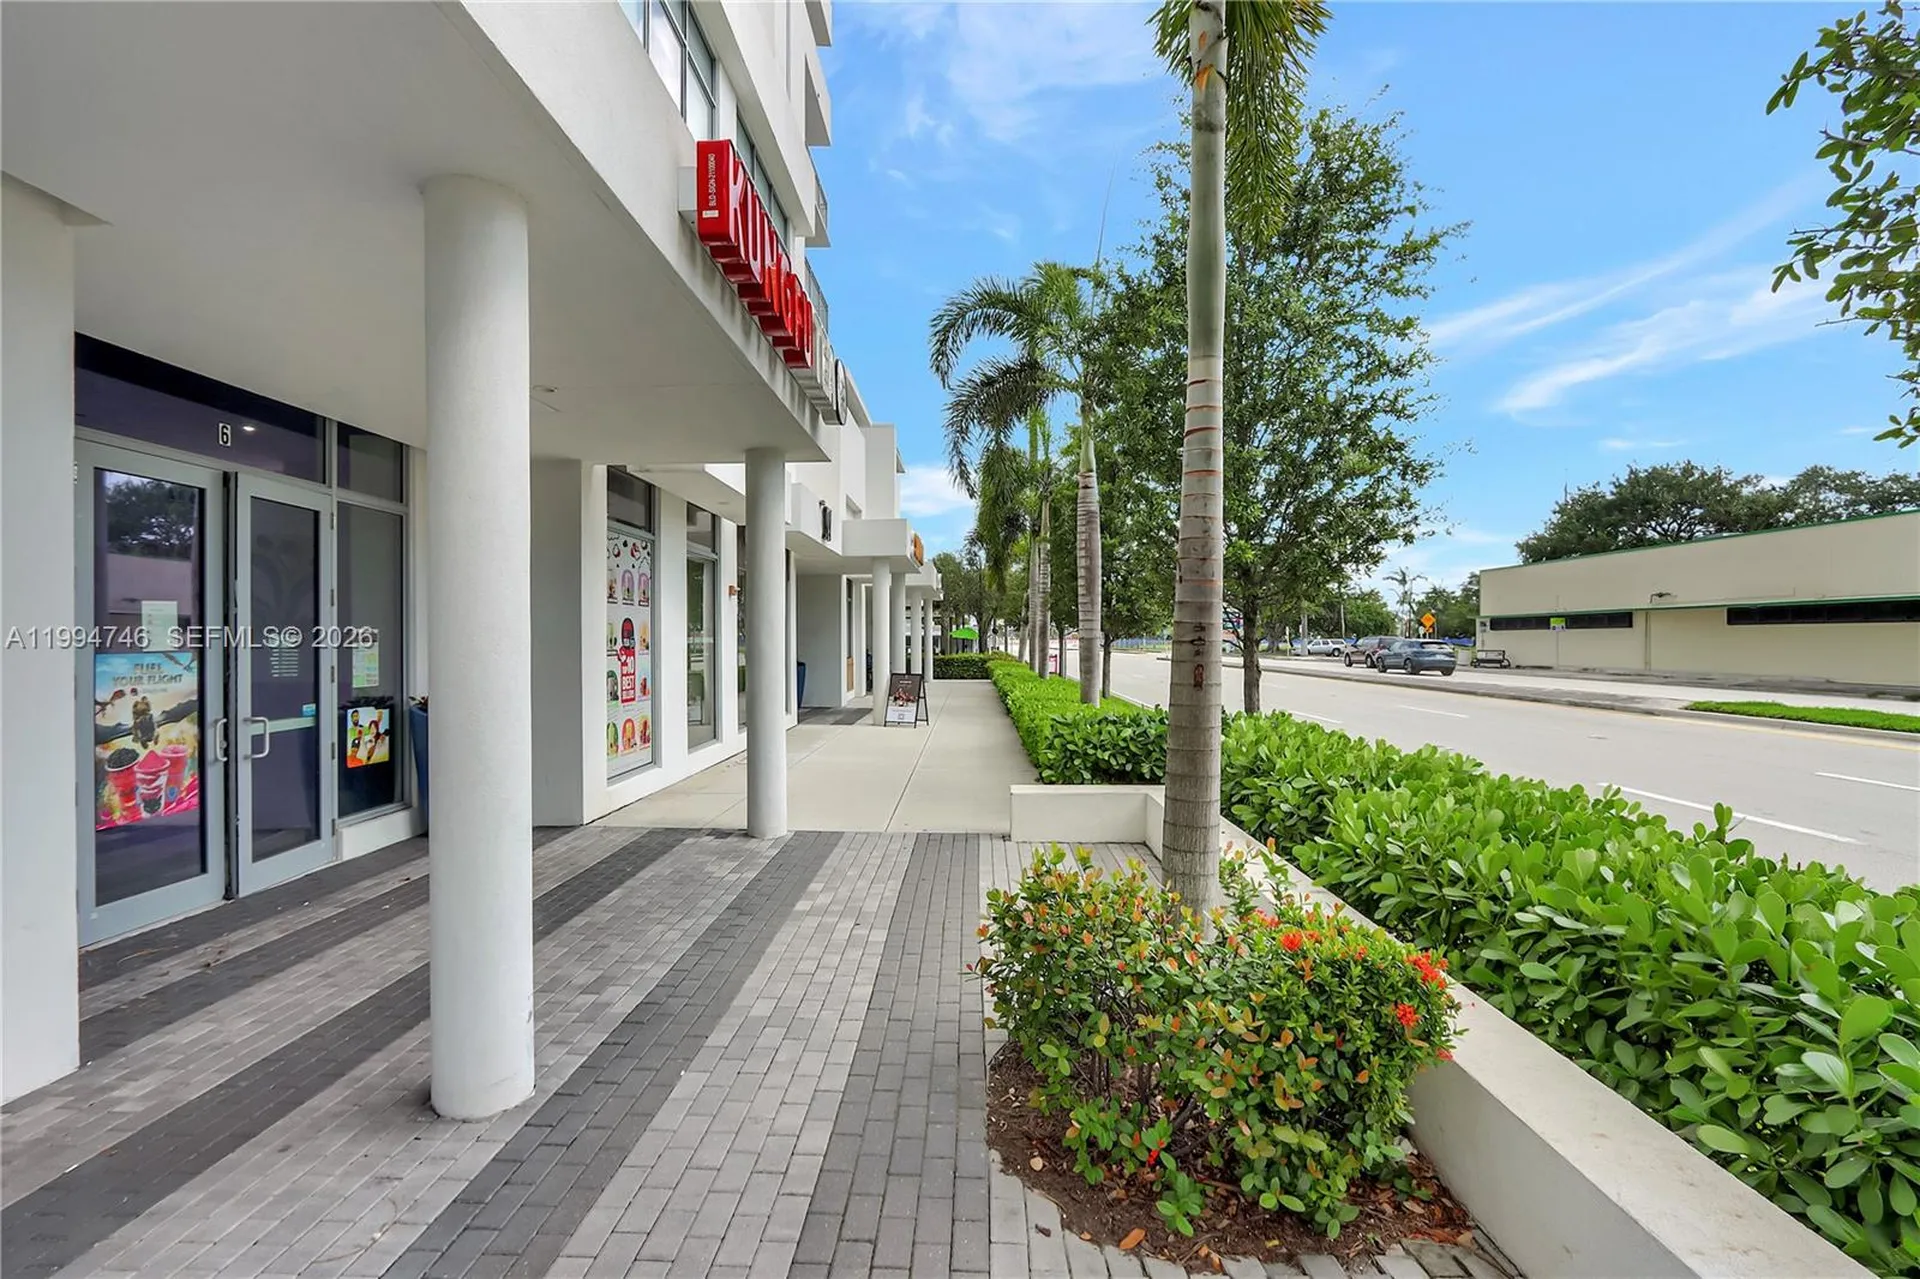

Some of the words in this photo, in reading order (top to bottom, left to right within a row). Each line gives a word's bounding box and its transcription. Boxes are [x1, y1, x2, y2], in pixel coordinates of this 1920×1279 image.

[220, 425, 230, 446] 6
[113, 675, 144, 687] YOUR
[147, 673, 183, 685] FLIGHT
[622, 675, 635, 690] BEST
